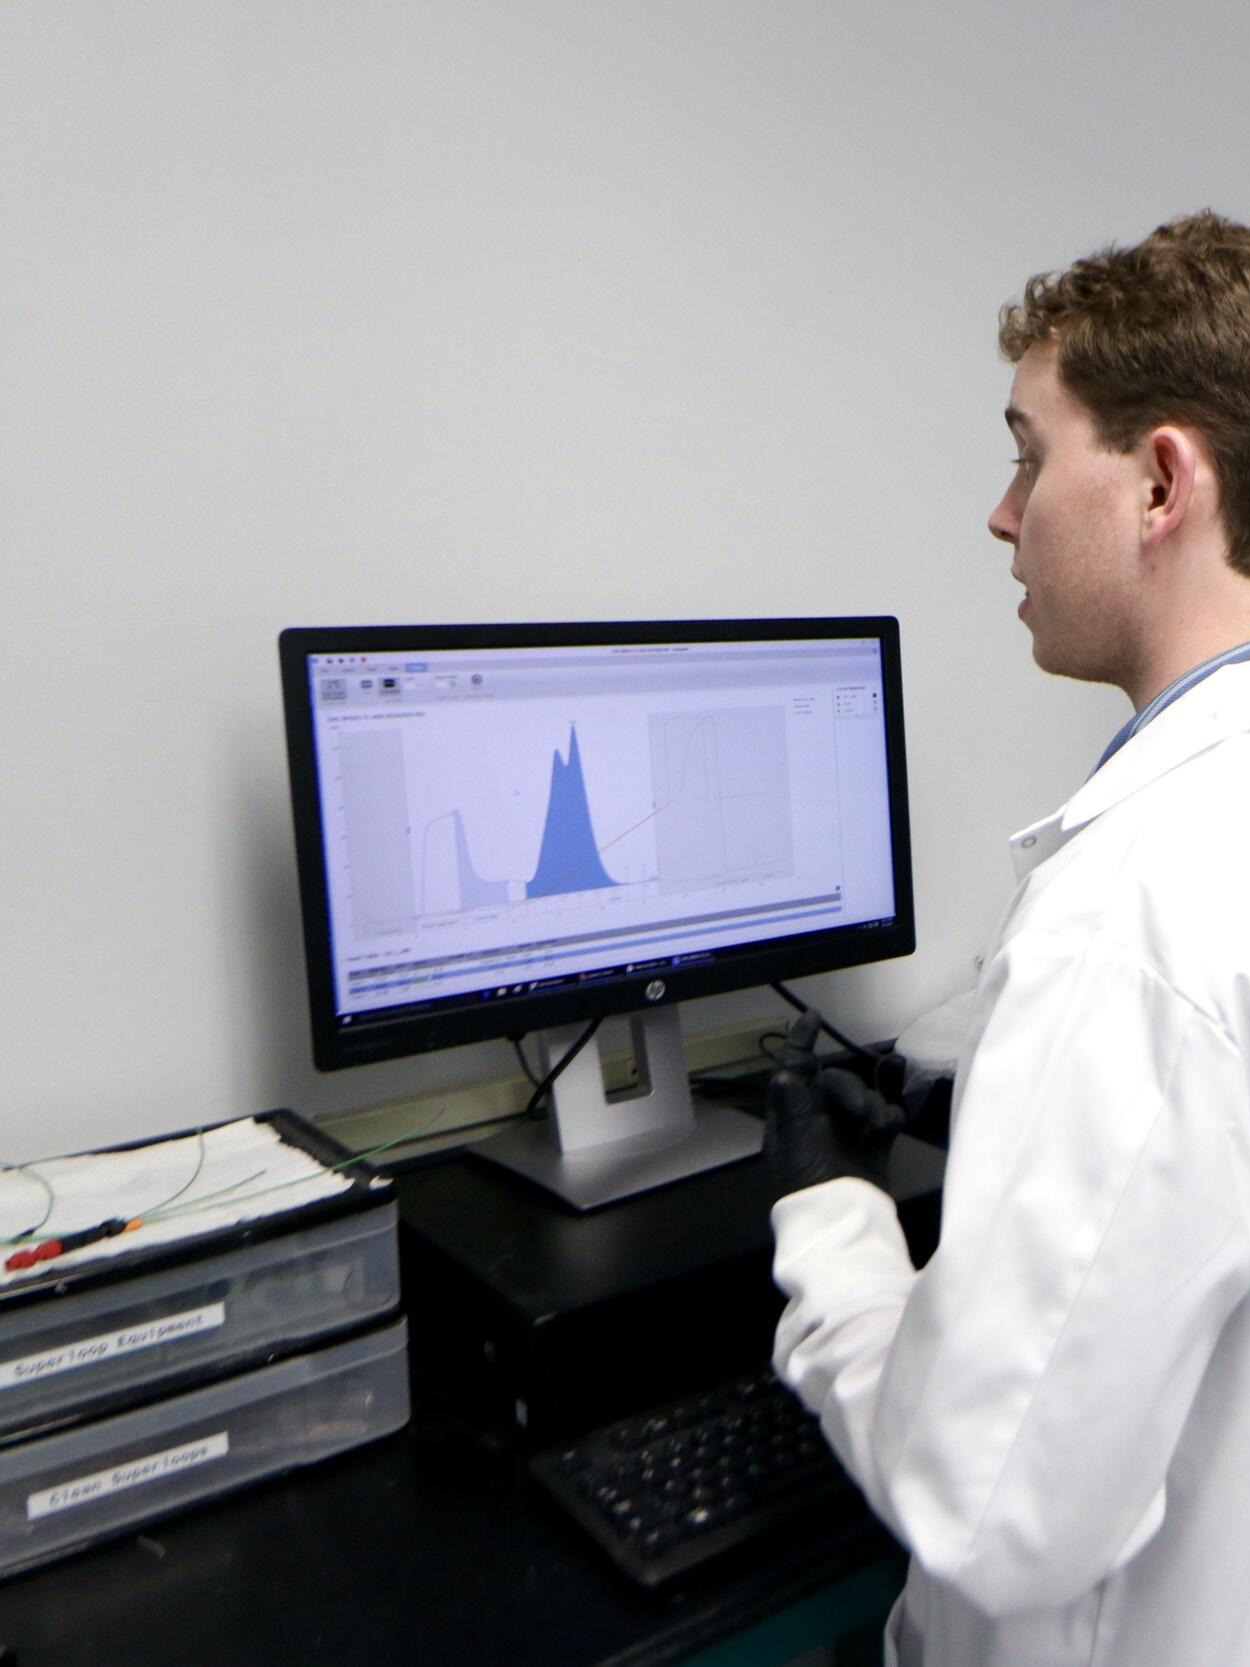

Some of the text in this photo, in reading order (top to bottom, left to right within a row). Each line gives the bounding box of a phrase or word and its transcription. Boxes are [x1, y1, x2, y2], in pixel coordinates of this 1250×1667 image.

[13, 1314, 204, 1378] Superloop Equipment
[49, 1445, 209, 1507] Clean Superloops
